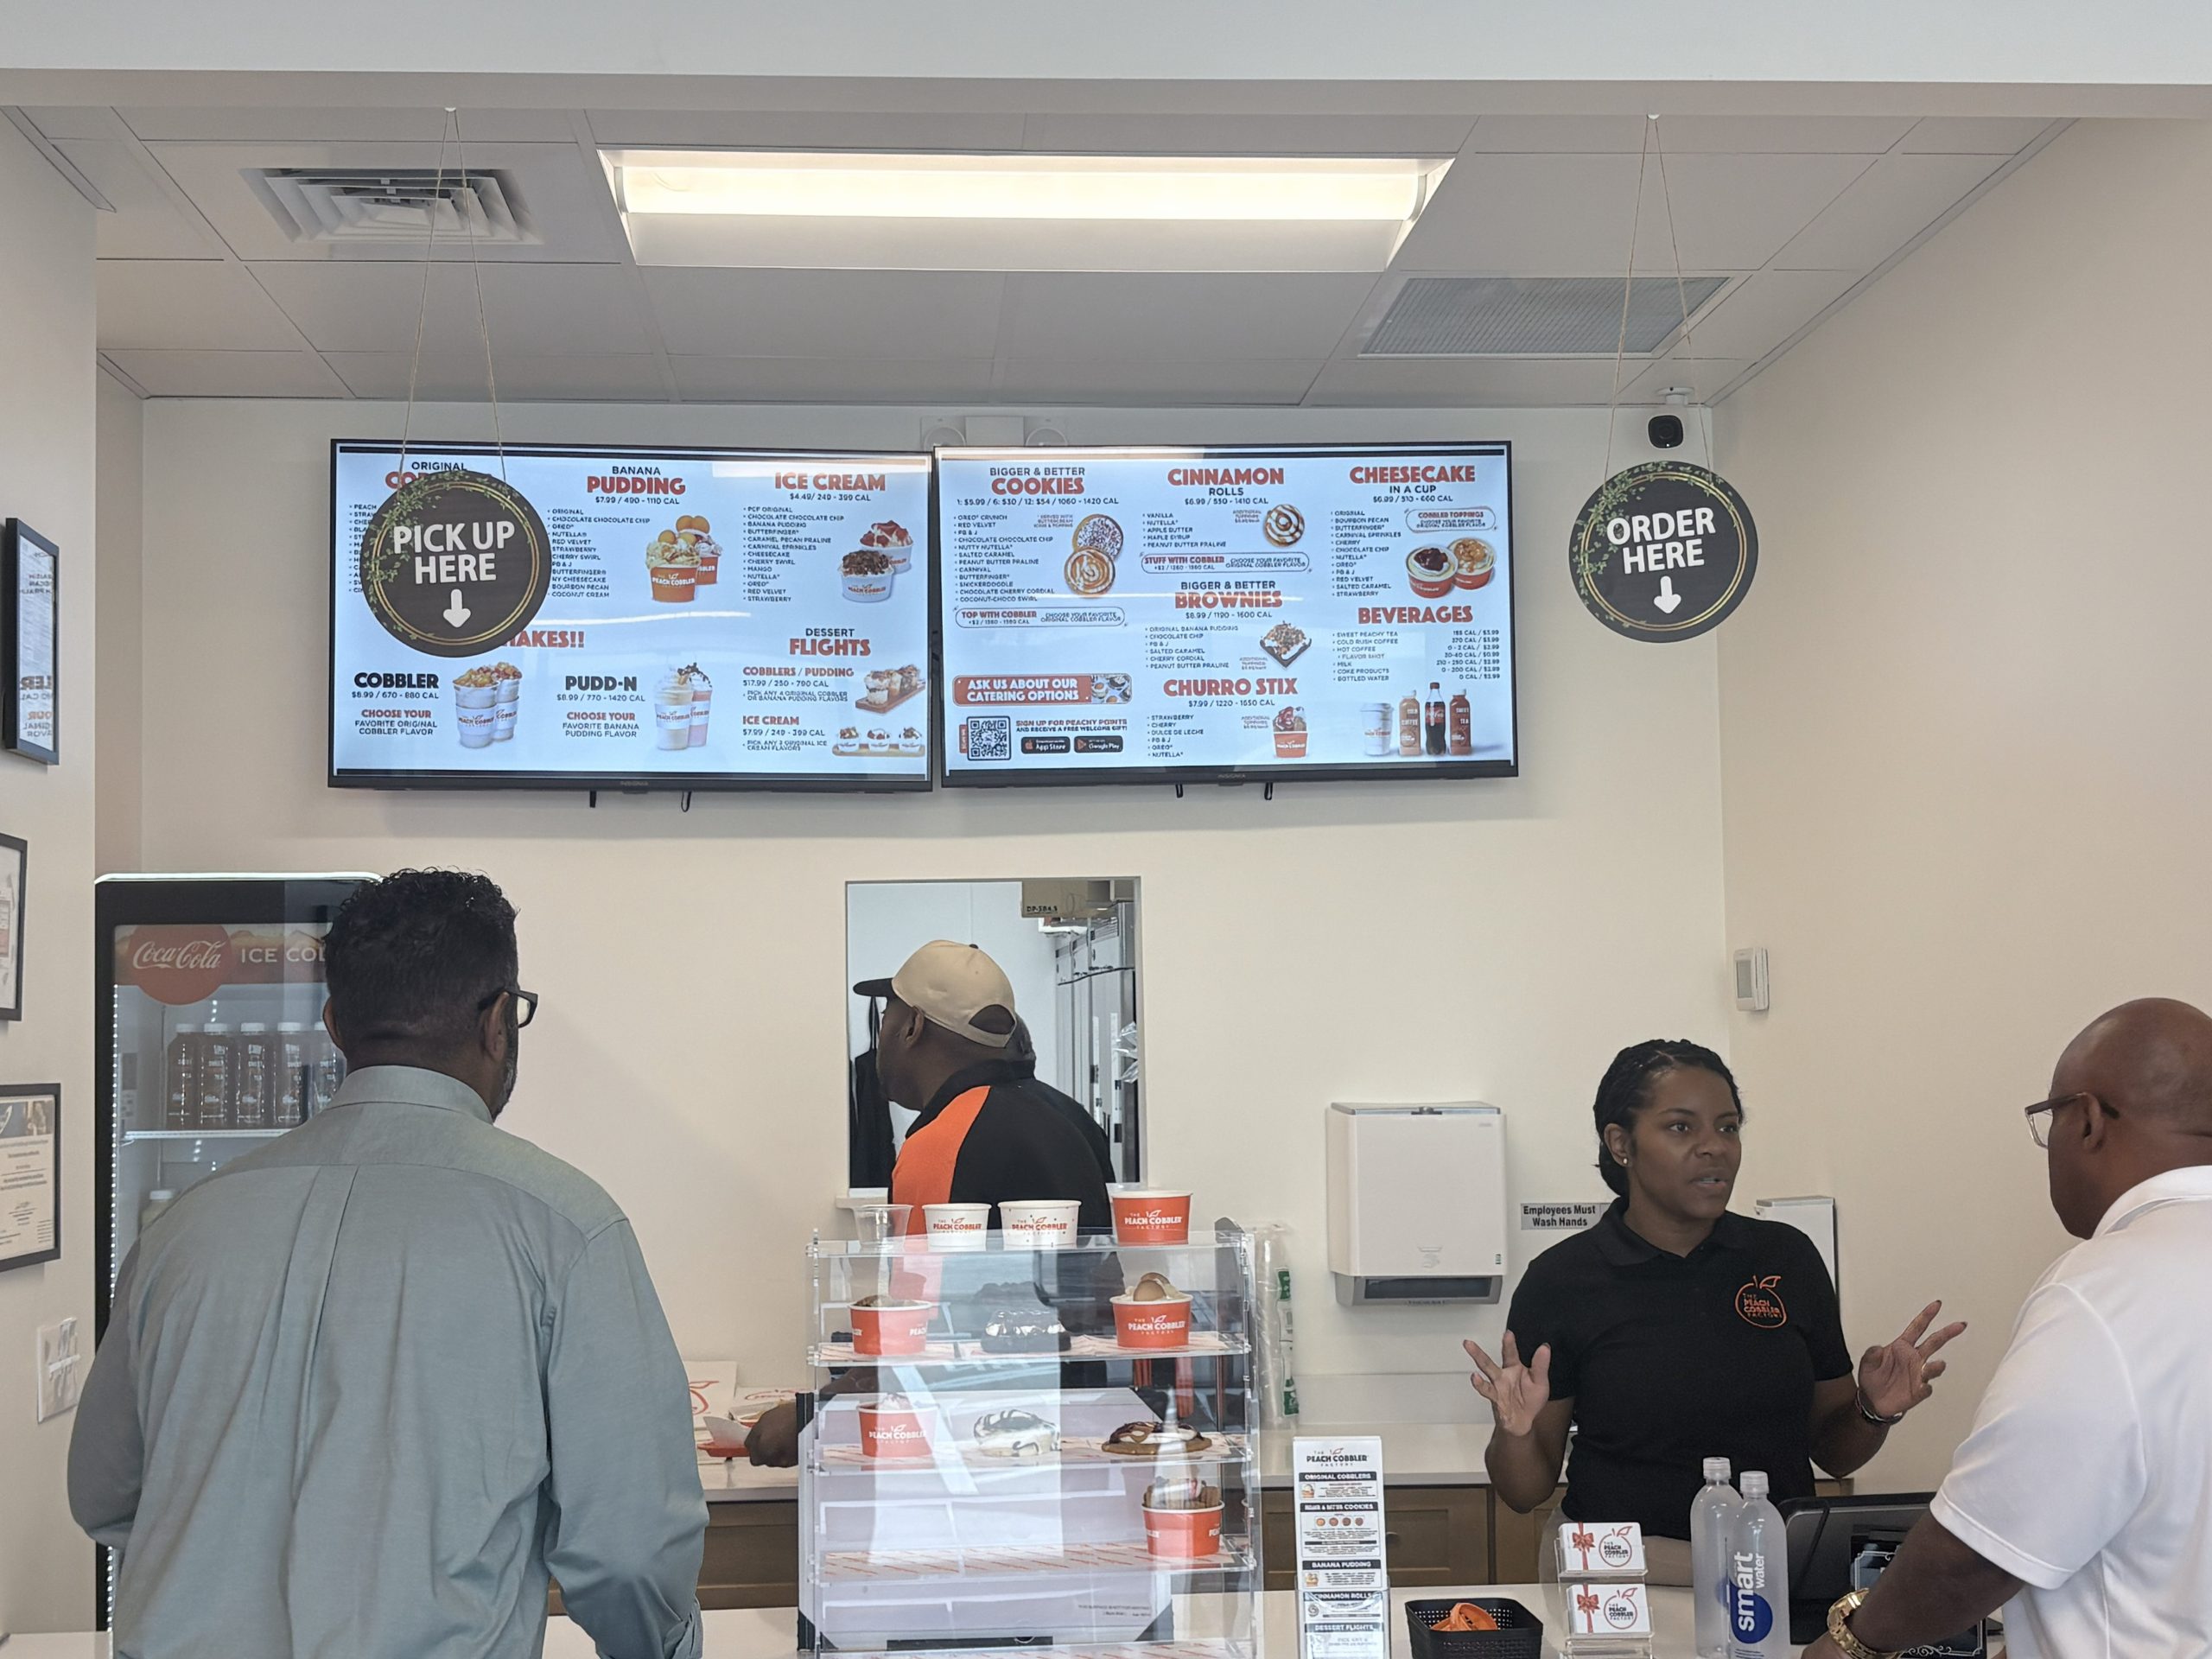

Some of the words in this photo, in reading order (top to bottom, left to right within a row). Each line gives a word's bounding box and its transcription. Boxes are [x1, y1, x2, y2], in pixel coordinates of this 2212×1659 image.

[411, 461, 467, 472] ORIGINAL
[613, 467, 660, 475] BANANA
[990, 467, 1030, 476] BIGGER
[775, 473, 808, 489] ICE
[813, 474, 886, 491] CREAM
[1168, 467, 1284, 486] CINNAMON
[1350, 466, 1475, 484] CHEESECAKE
[588, 476, 685, 495] PUDDING
[992, 477, 1084, 495] COOKIES
[1210, 487, 1243, 496] ROLLS
[1415, 485, 1436, 493] CUP
[1607, 507, 1716, 545] ORDER
[393, 524, 465, 554] PICK
[473, 521, 515, 550] UP
[1623, 539, 1705, 575] HERE
[415, 553, 496, 584] HERE
[1235, 581, 1275, 589] BETTER
[1175, 591, 1282, 609] BROWNIES
[1358, 606, 1472, 624] BEVERAGES
[806, 628, 855, 637] DESSERT
[790, 638, 871, 657] FLIGHTS
[743, 667, 796, 677] COBBLERS
[805, 668, 854, 677] PUDDING
[354, 672, 439, 689] COBBLER
[566, 676, 637, 691] PUDD-N
[968, 678, 989, 690] ASK
[994, 678, 1007, 690] US
[1009, 678, 1049, 690] ABOUT
[1052, 678, 1077, 689] OUR
[1164, 678, 1251, 696] CHURRO
[1256, 678, 1298, 695] STIX
[967, 690, 1025, 702] CATERING
[1027, 690, 1078, 701] OPTIONS
[361, 709, 402, 718] CHOOSE
[567, 712, 607, 721] CHOOSE
[743, 715, 760, 725] ICE
[762, 716, 799, 725] CREAM
[563, 722, 601, 731] FAVORITE
[133, 940, 227, 969] Coca-Cola
[242, 948, 277, 963] ICE
[286, 947, 325, 963] COL
[1523, 1205, 1572, 1216] Employees
[1574, 1205, 1595, 1214] Must
[1533, 1217, 1556, 1226] Wash
[1559, 1217, 1587, 1226] Hands
[1754, 1553, 1764, 1588] water
[1734, 1552, 1755, 1631] smart
